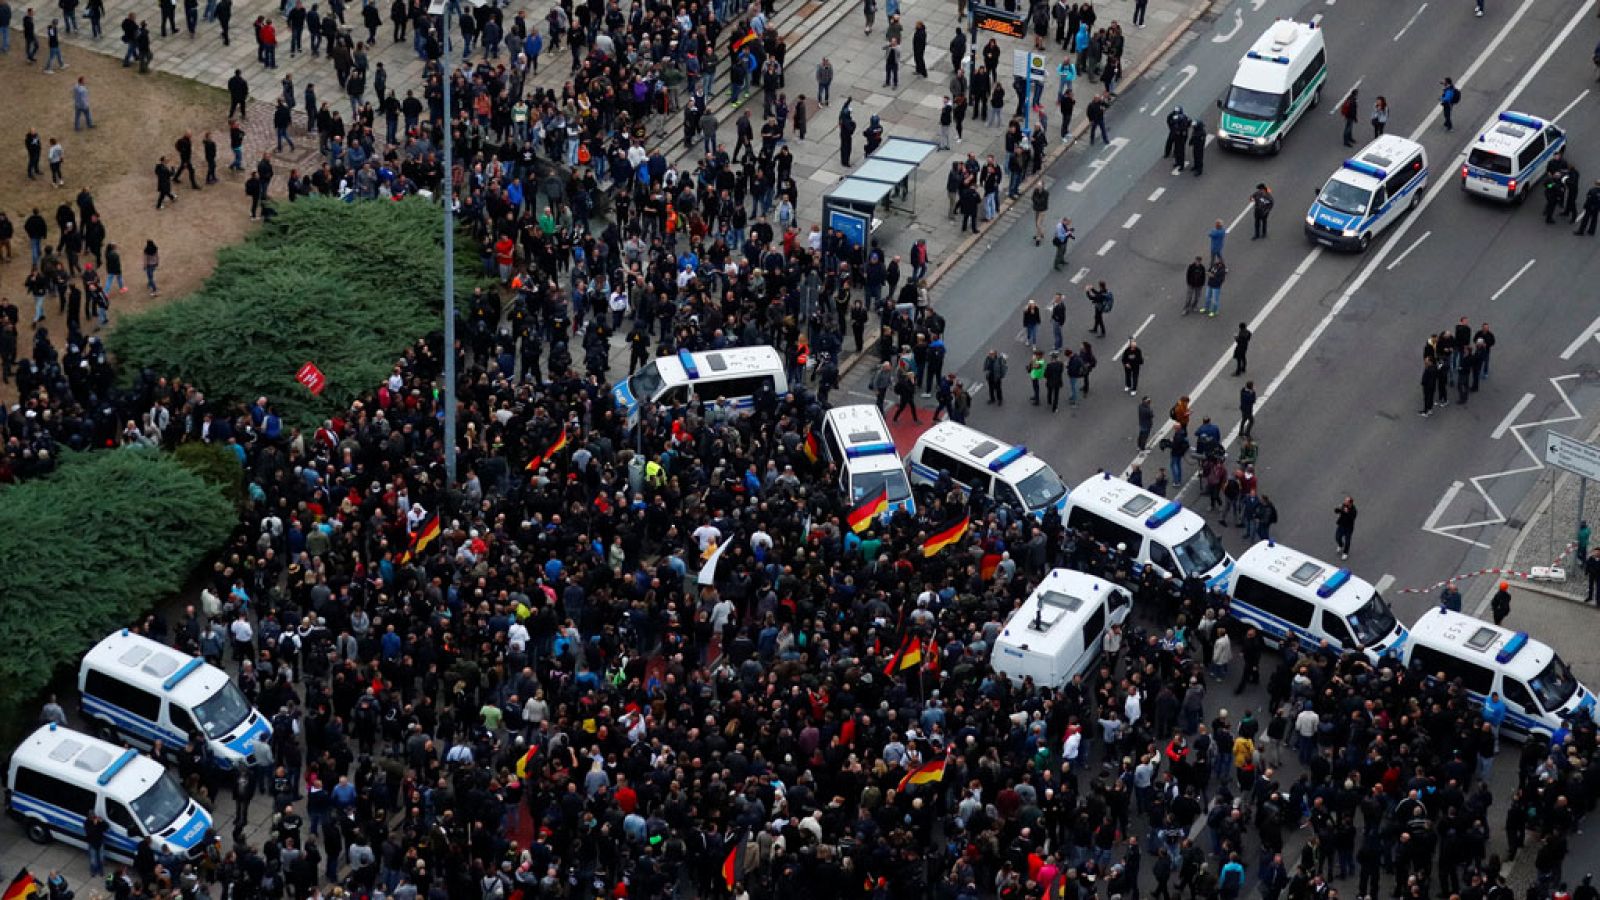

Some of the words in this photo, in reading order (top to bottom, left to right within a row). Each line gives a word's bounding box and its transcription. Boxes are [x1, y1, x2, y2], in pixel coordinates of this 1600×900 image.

[1231, 122, 1256, 132] POLIZEI
[1320, 213, 1344, 226] POLIZEI
[183, 821, 204, 841] POLIZEI
